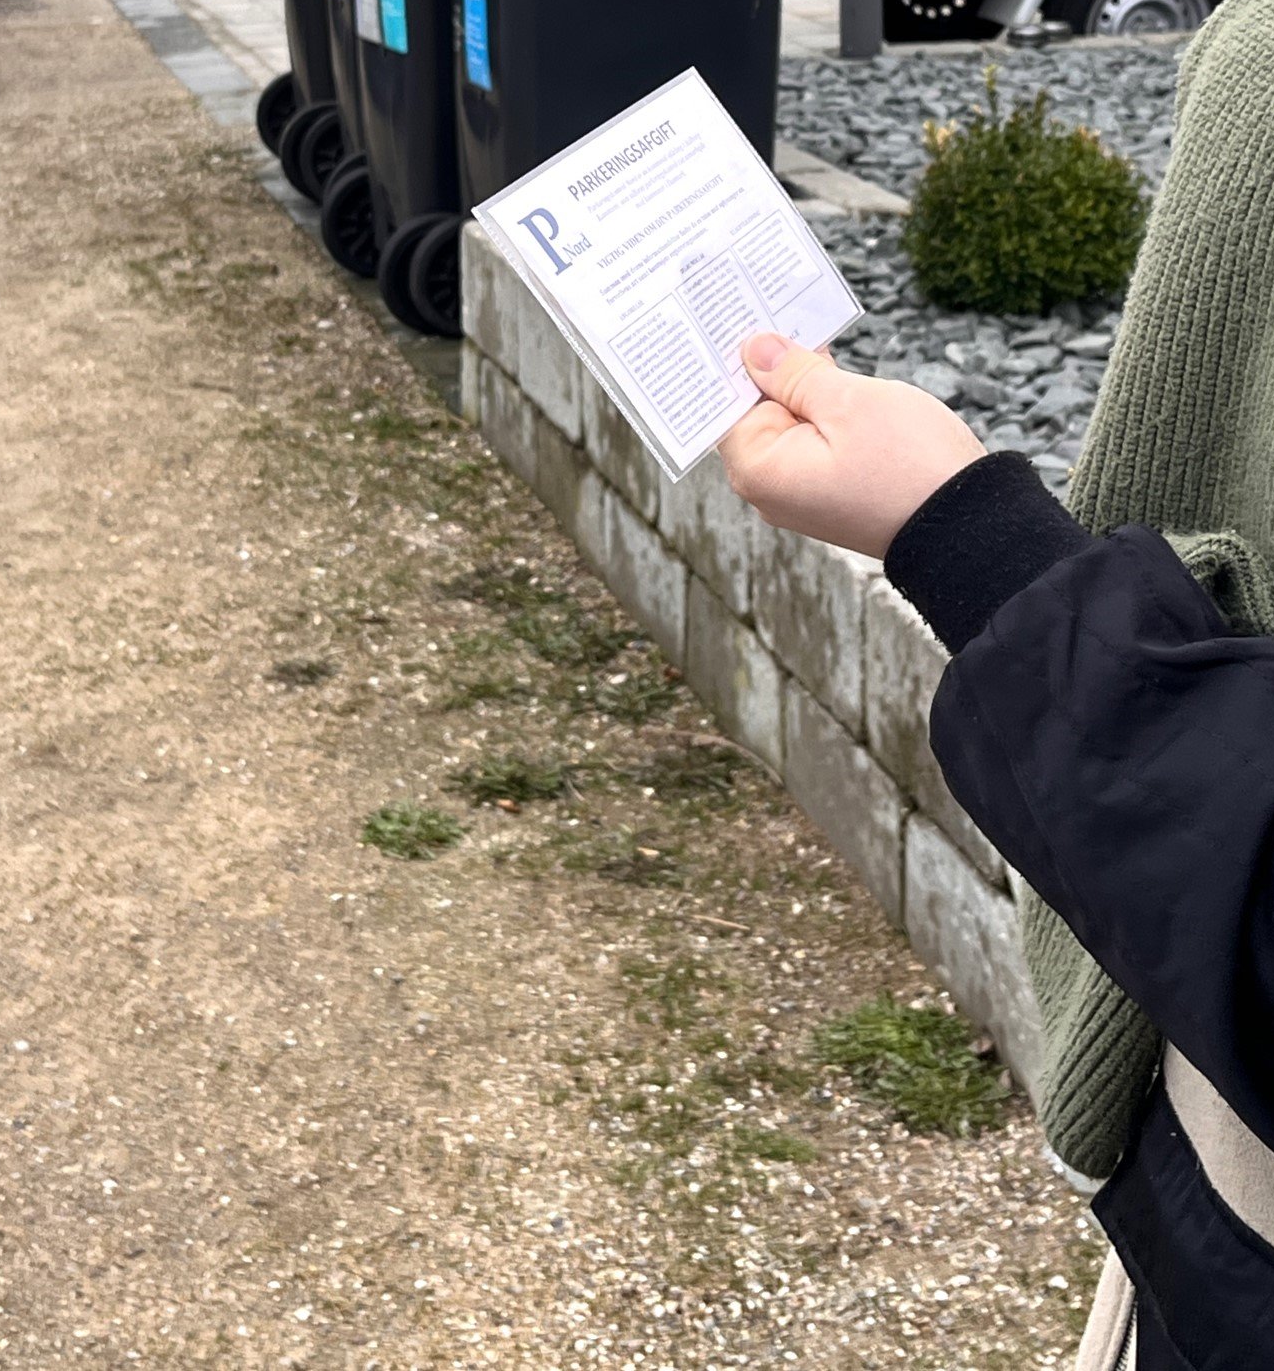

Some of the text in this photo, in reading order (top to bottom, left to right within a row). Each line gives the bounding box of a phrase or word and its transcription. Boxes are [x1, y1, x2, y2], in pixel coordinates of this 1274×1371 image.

[568, 120, 677, 201] PARKERINGSAFGIFT
[517, 207, 573, 277] P
[562, 234, 593, 262] Nord
[596, 245, 625, 270] VIGTIG
[621, 229, 646, 252] VIDEN
[642, 220, 657, 237] OM
